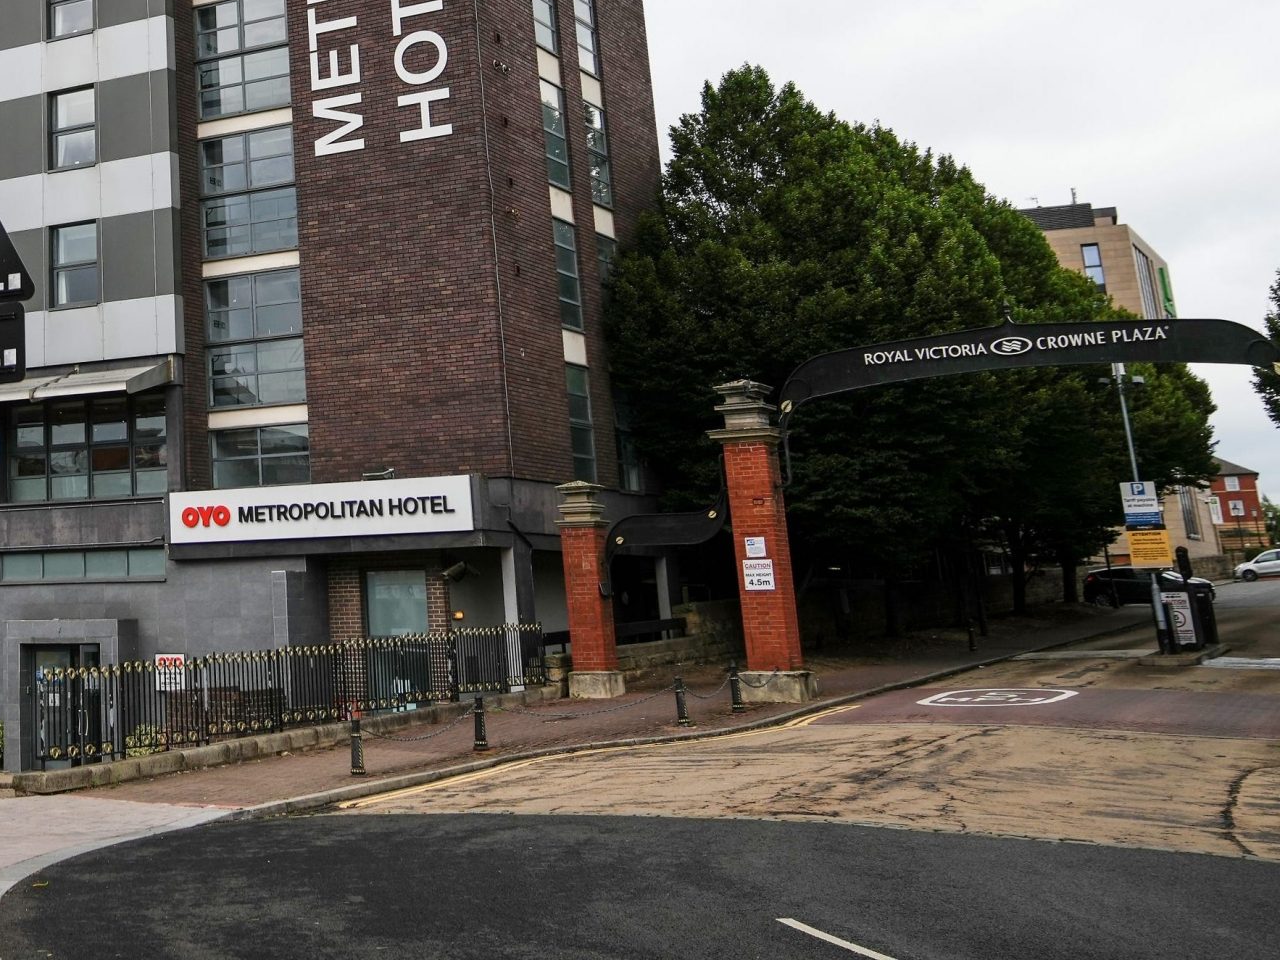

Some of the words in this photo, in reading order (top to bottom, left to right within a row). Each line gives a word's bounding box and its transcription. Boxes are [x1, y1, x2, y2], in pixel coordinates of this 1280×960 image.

[863, 349, 913, 366] ROYAL
[914, 342, 988, 361] VICTORIA
[1036, 331, 1105, 350] CROWNE
[181, 505, 231, 528] OYO
[238, 498, 383, 523] METROPOLITAN
[388, 495, 456, 516] HOTEL
